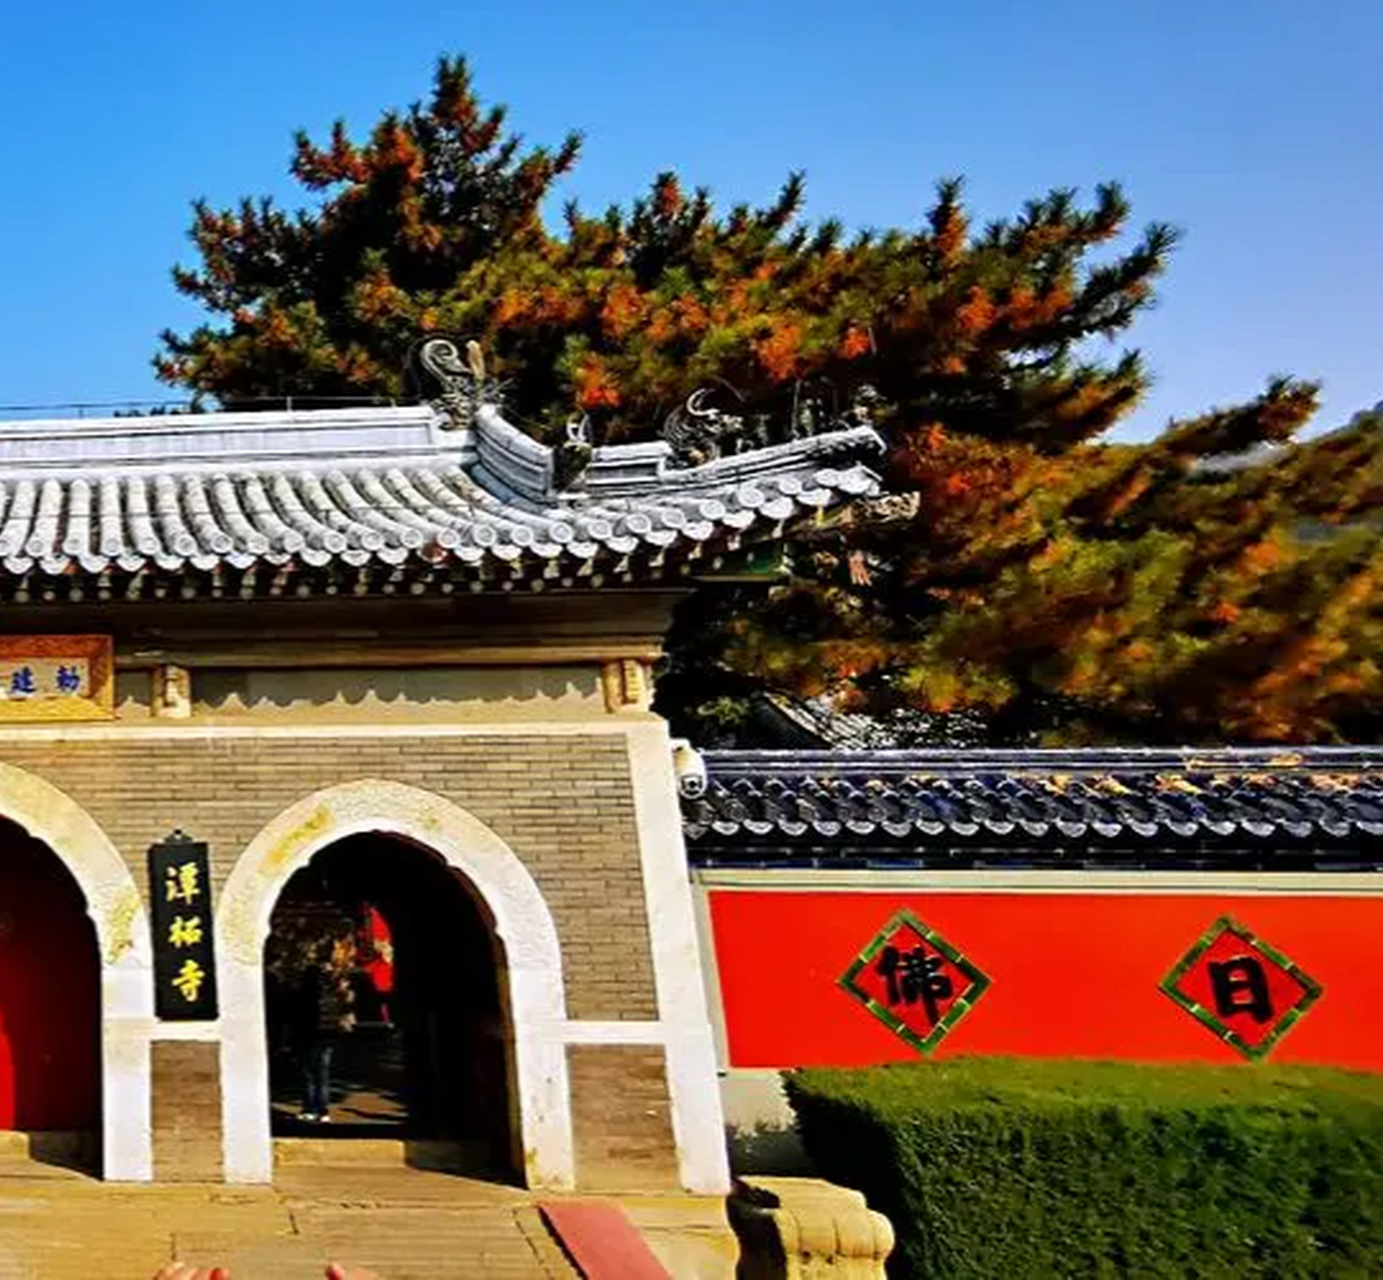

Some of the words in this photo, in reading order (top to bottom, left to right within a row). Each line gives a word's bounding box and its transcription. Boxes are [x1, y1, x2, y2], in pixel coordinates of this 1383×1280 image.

[165, 861, 206, 1002] 潭柘寺
[875, 943, 954, 1027] 佛
[1206, 954, 1274, 1025] 日
